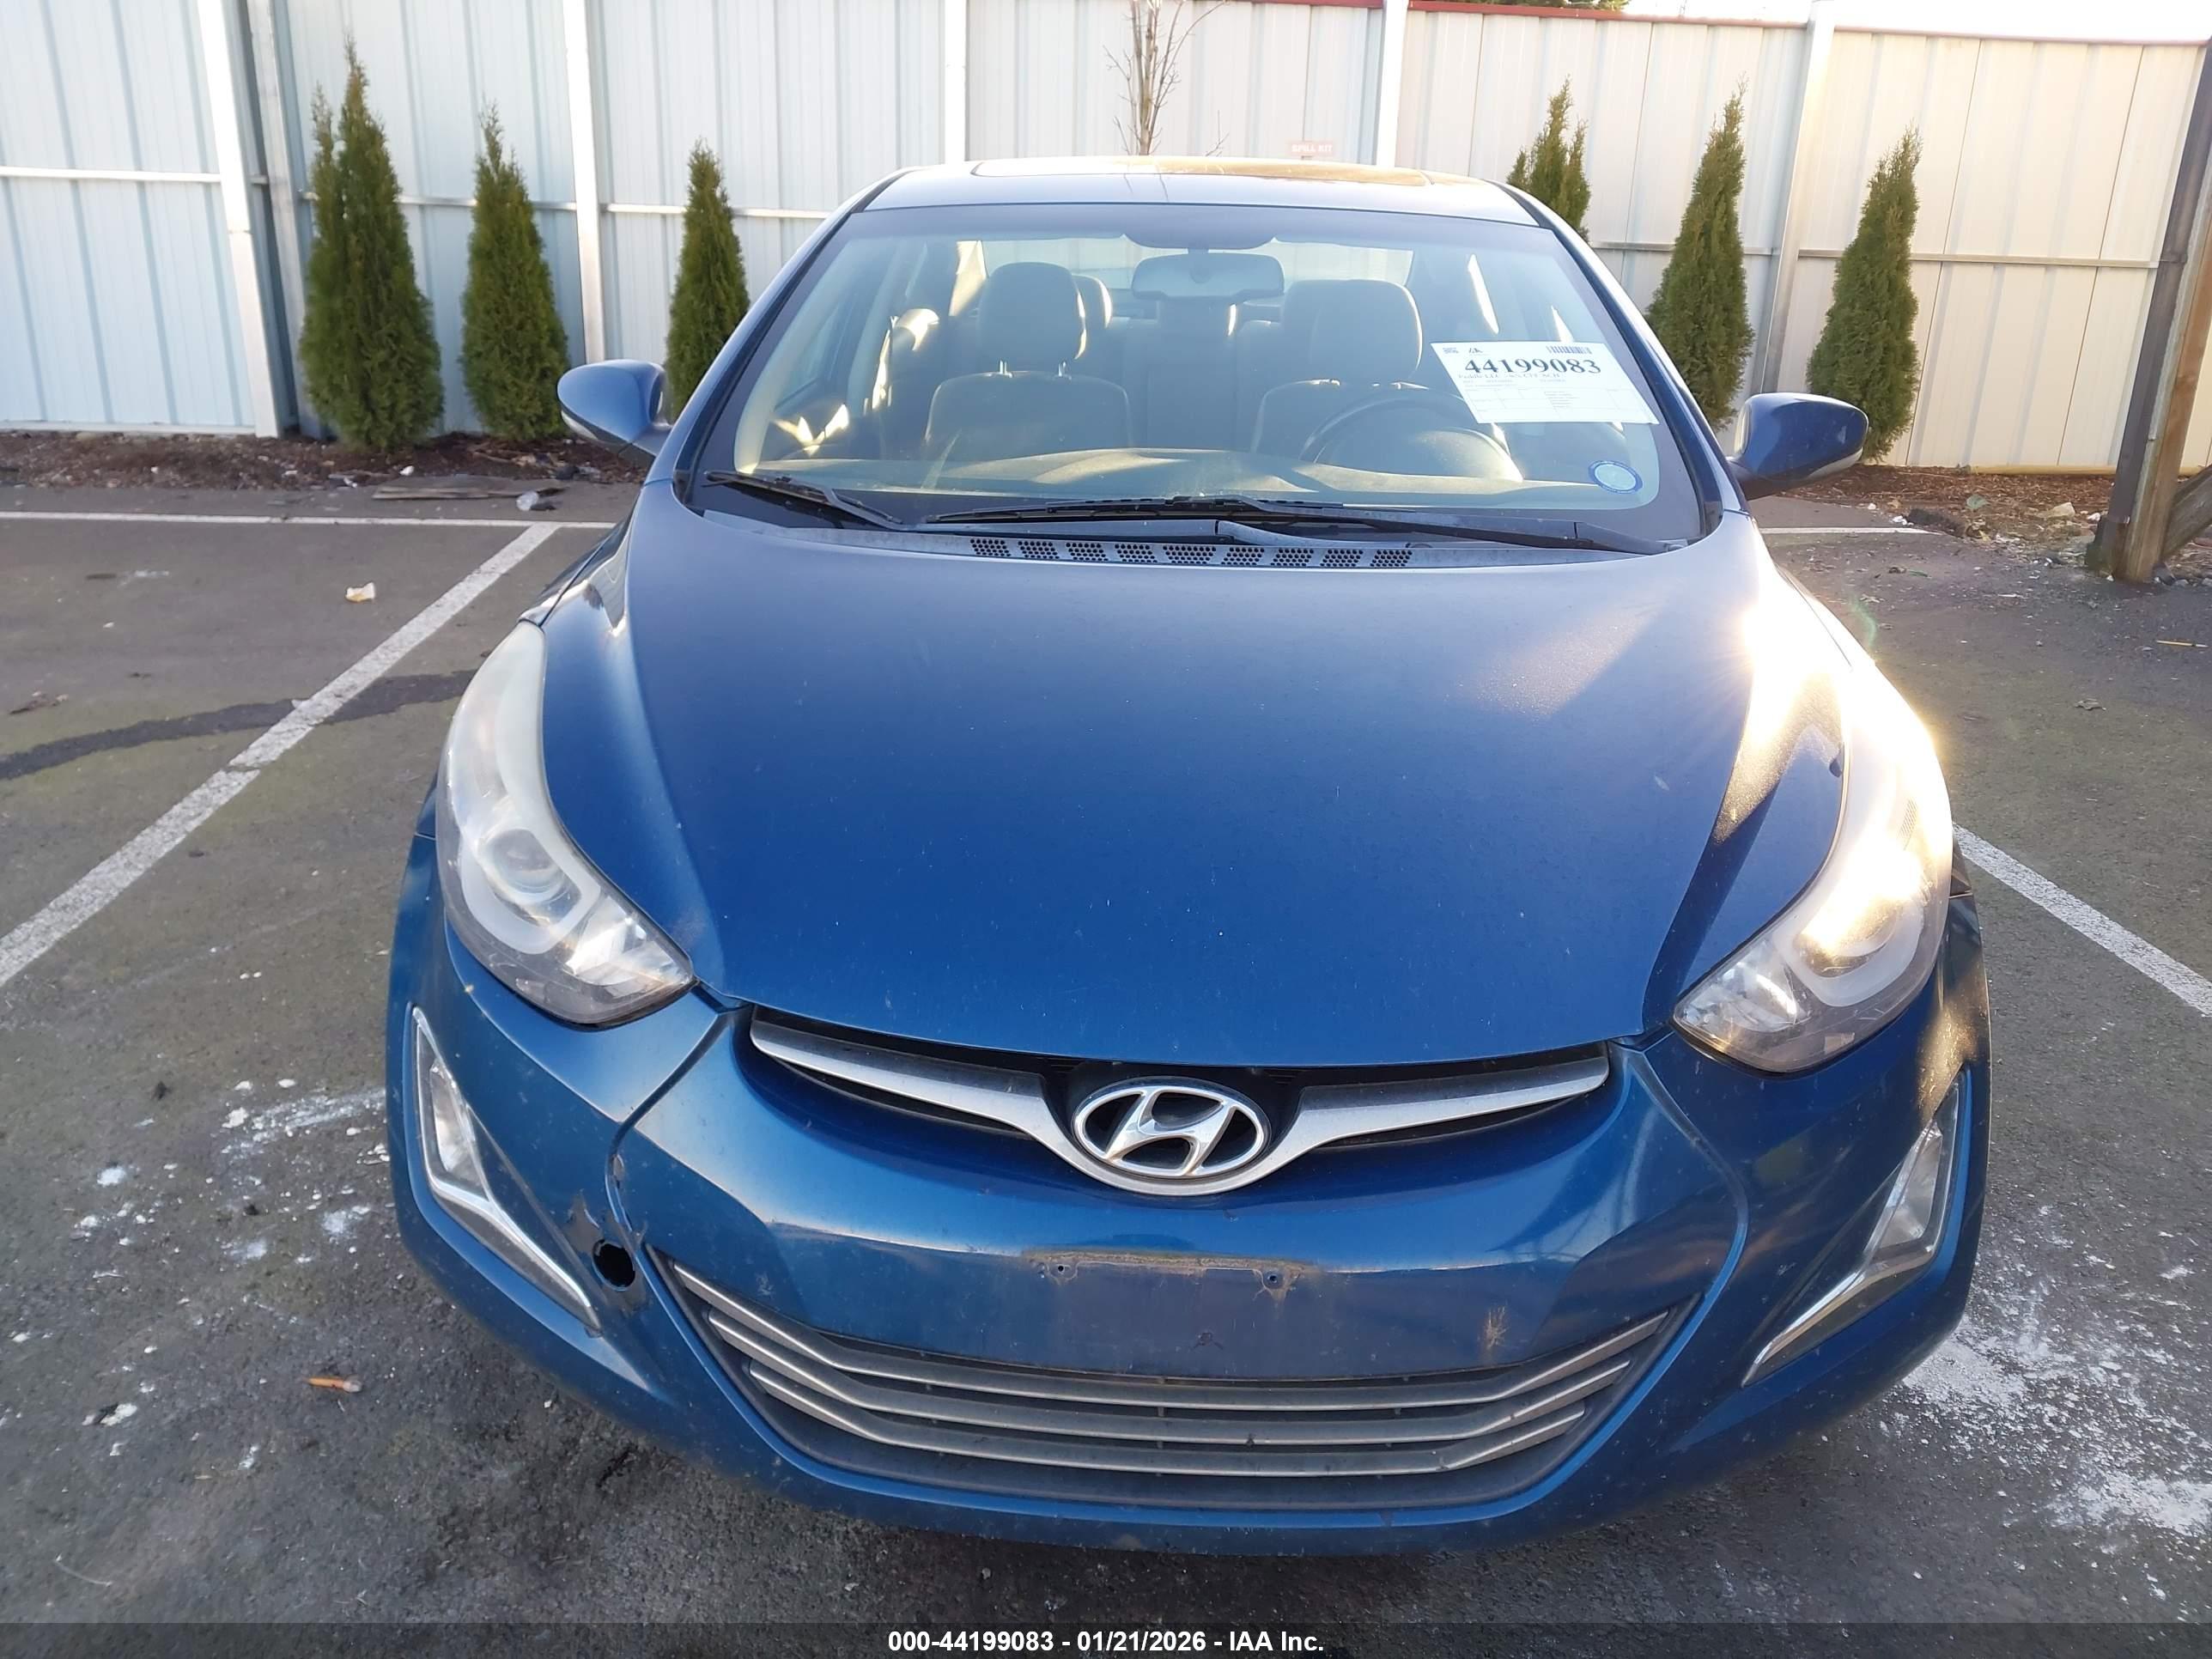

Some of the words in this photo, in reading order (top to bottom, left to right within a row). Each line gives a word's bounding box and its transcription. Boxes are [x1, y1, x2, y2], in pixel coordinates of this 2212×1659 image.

[1291, 143, 1316, 153] SPILL
[1318, 143, 1333, 152] KIT
[1464, 358, 1601, 374] 44199083
